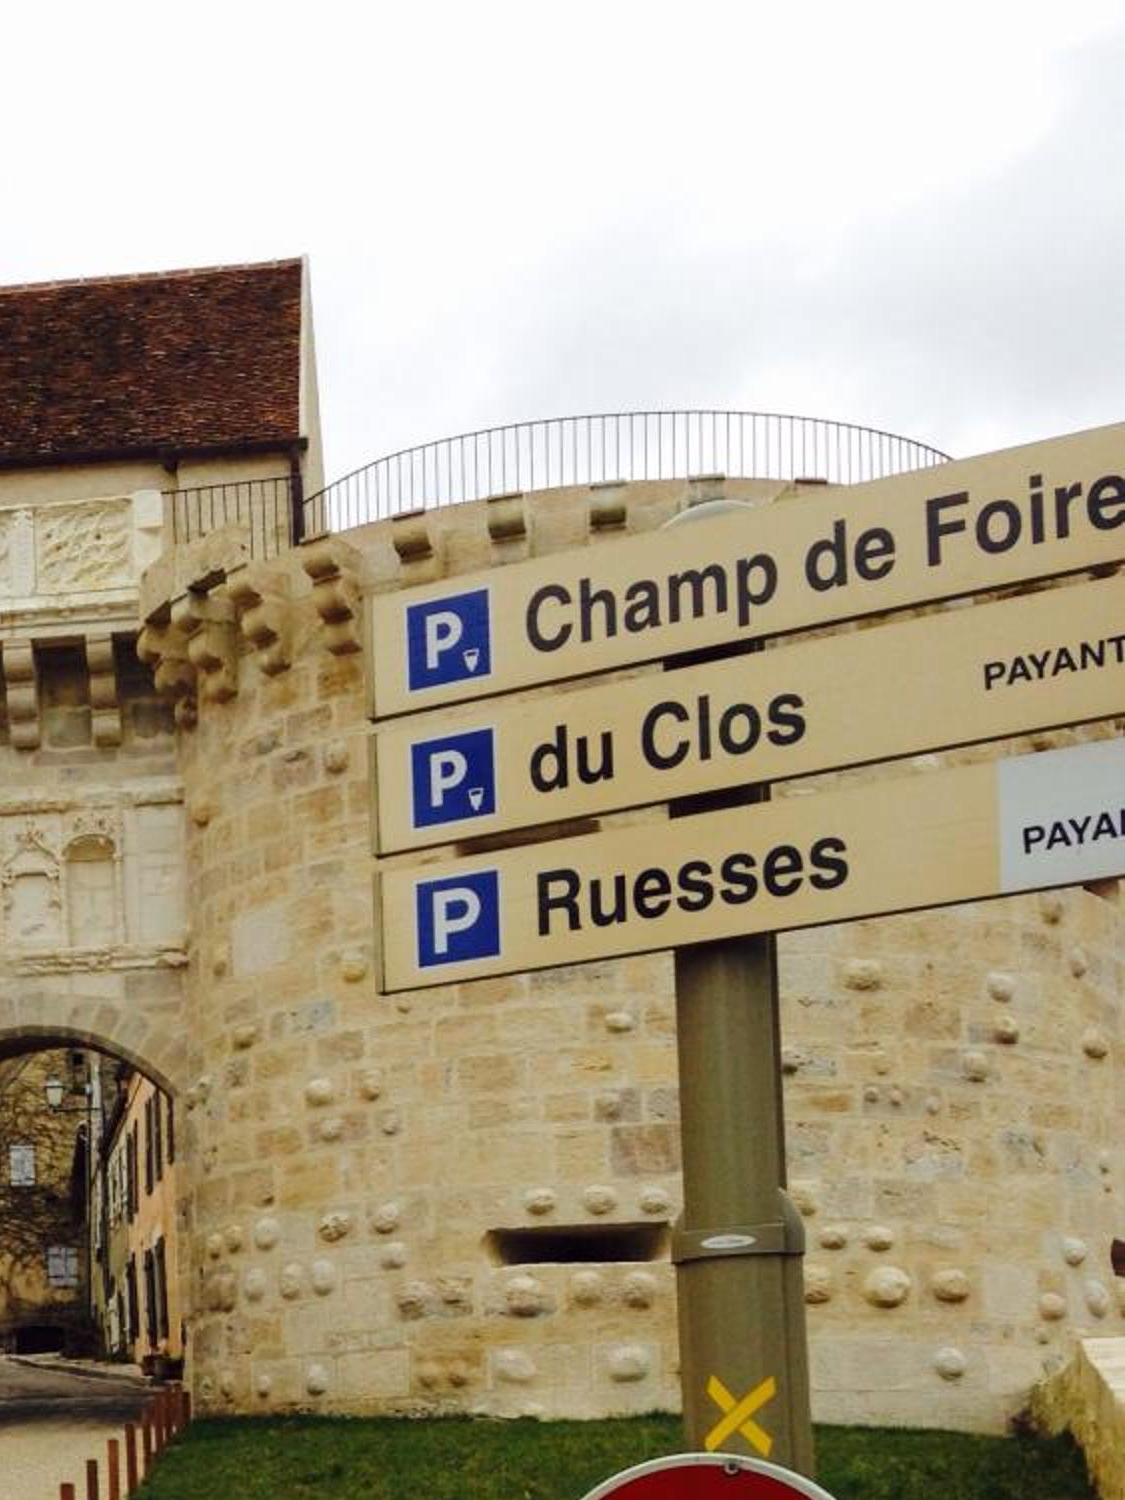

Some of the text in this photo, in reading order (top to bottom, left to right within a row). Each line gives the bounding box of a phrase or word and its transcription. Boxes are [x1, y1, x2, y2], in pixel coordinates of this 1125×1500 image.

[426, 474, 1125, 670] P Champ de Foire
[430, 692, 807, 807] P du Clos
[1023, 807, 1125, 854] PAYA
[433, 836, 850, 954] P Ruesses
